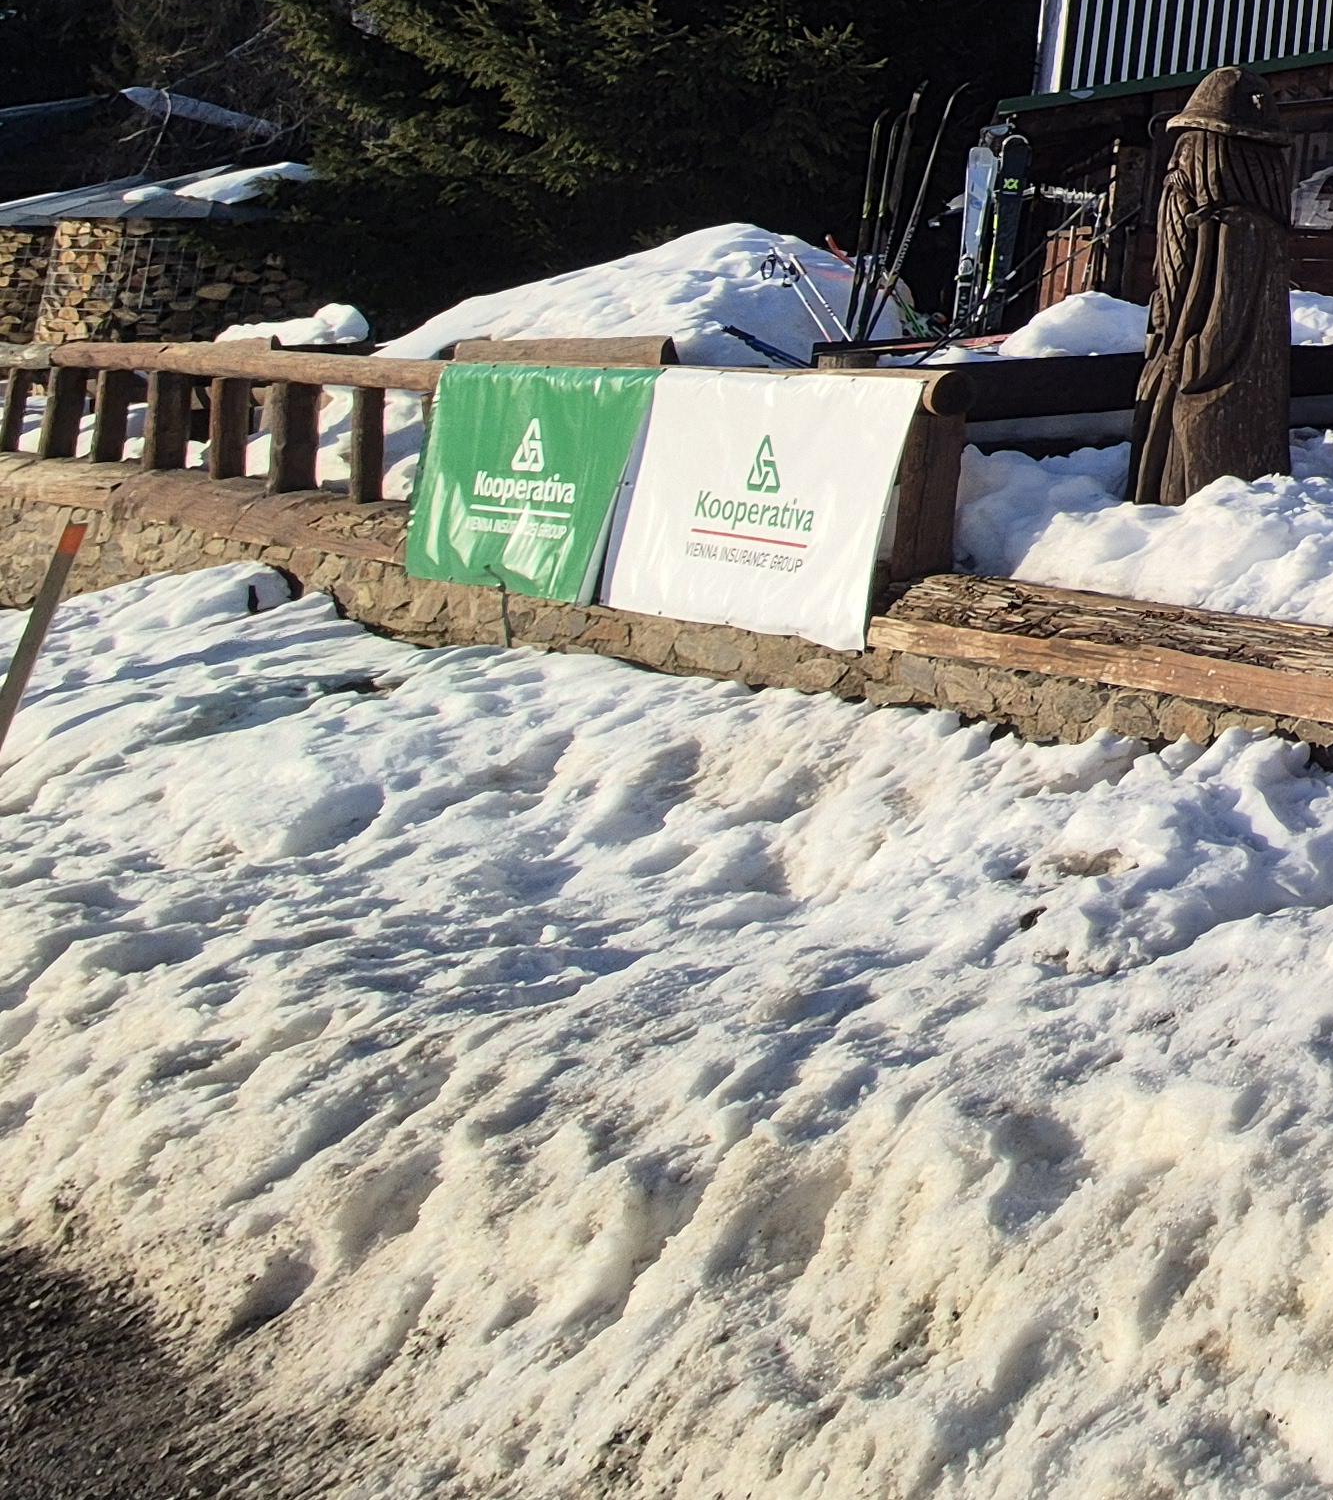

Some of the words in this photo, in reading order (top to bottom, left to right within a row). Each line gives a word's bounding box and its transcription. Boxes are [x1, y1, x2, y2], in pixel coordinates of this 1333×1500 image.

[474, 470, 576, 505] Kooperativa
[695, 490, 815, 532] Kooperativa
[685, 541, 718, 561] VIENNA
[719, 546, 771, 569] INSURANCE
[769, 553, 803, 573] GROUP
